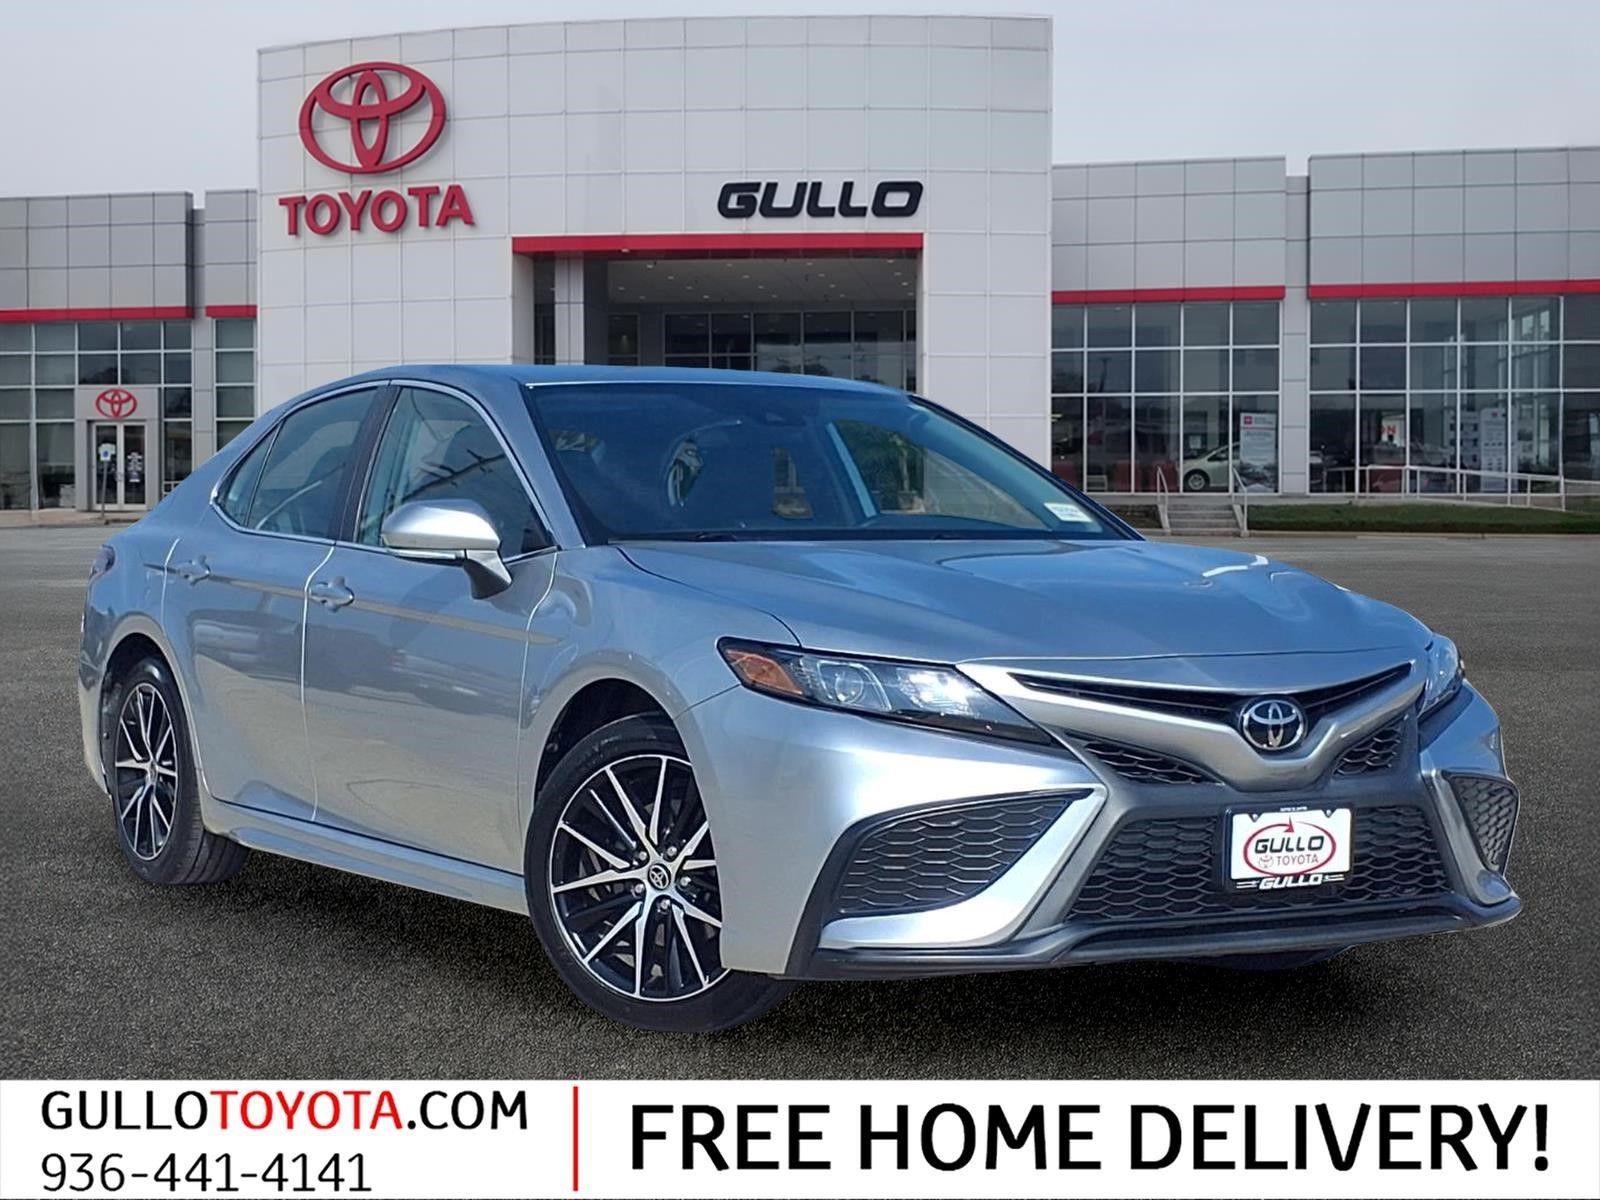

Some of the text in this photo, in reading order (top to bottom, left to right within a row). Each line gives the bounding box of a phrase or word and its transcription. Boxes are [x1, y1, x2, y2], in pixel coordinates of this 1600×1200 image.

[718, 181, 924, 219] GULLO
[279, 184, 475, 236] TOYOTA
[1255, 836, 1324, 854] GULLO
[1277, 854, 1319, 866] TOYOTA
[1259, 874, 1323, 890] GULLO
